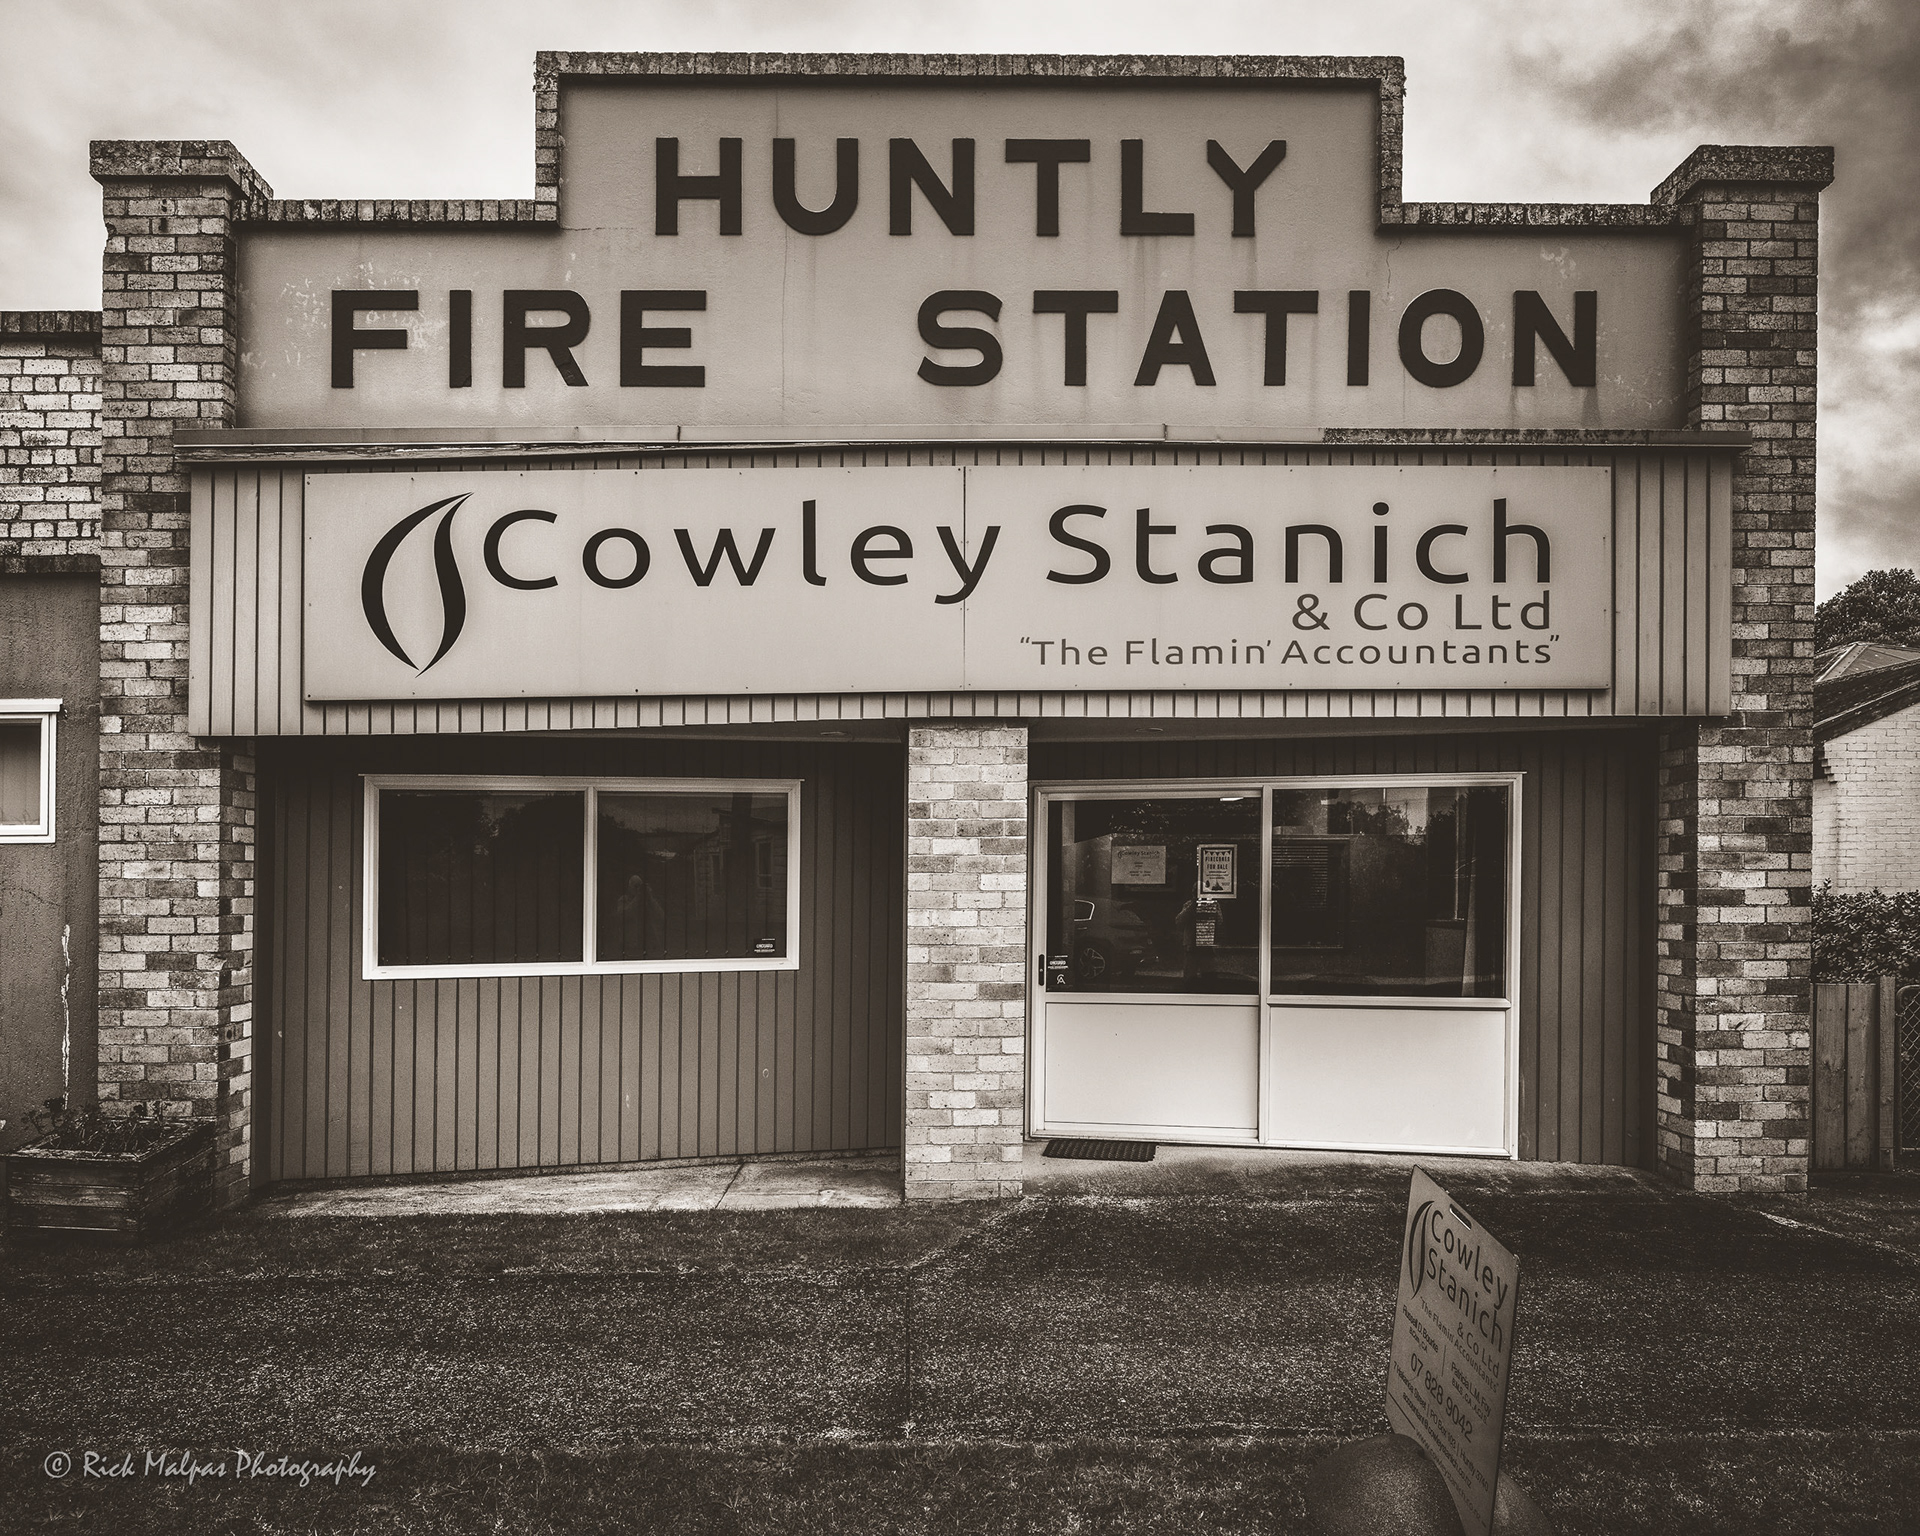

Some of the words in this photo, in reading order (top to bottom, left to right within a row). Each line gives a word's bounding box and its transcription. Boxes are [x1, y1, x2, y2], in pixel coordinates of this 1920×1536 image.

[655, 137, 1287, 237] HUNTLY
[331, 289, 707, 388] FIRE
[917, 288, 1597, 388] STATION
[483, 499, 1002, 606] Cowley
[1046, 497, 1552, 585] Stanich
[1291, 593, 1331, 631] &
[1353, 593, 1429, 631] Co
[1454, 590, 1551, 631] Ltd
[1427, 1249, 1503, 1353] Stanich
[1431, 1209, 1508, 1309] Cowley
[1411, 1353, 1423, 1377] 07
[1425, 1371, 1443, 1405] 828
[1446, 1397, 1472, 1443] 9042
[1457, 1322, 1463, 1339] &
[1467, 1332, 1479, 1355] Co
[1482, 1348, 1499, 1378] Ltd
